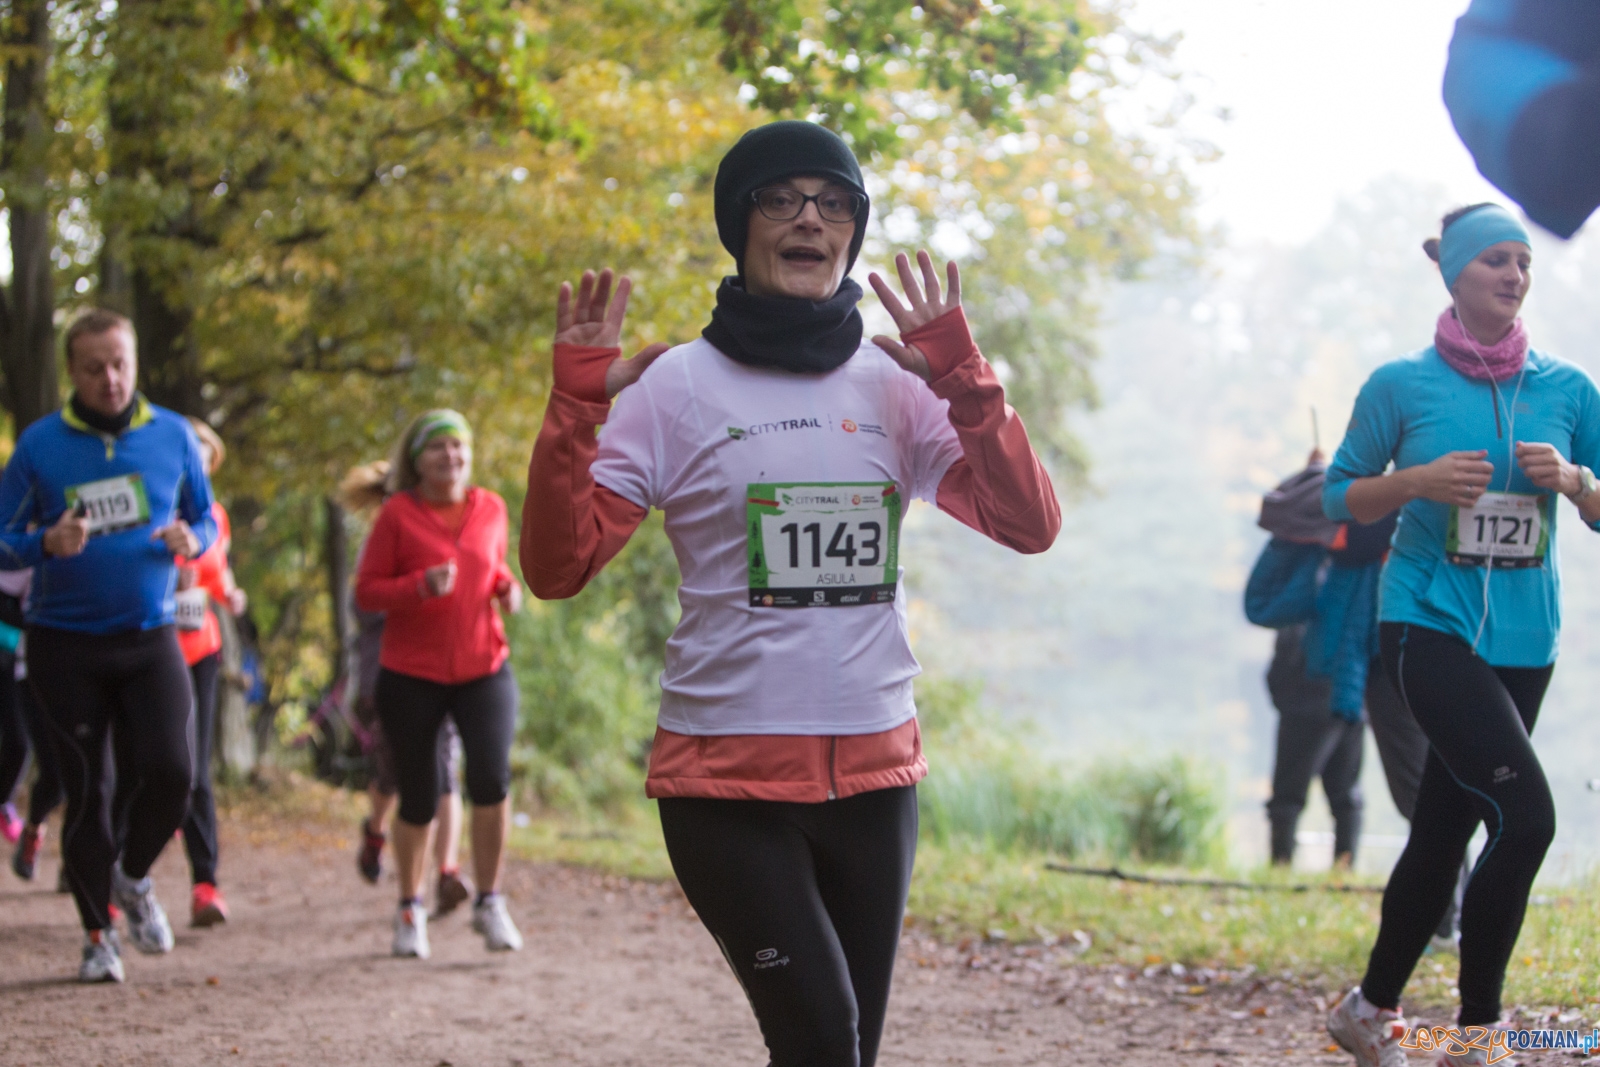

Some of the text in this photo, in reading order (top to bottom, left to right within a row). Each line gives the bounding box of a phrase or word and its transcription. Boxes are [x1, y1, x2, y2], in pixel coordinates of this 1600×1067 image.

[780, 521, 881, 568] 1143
[1473, 513, 1533, 545] 1121
[816, 573, 856, 585] ASIULA
